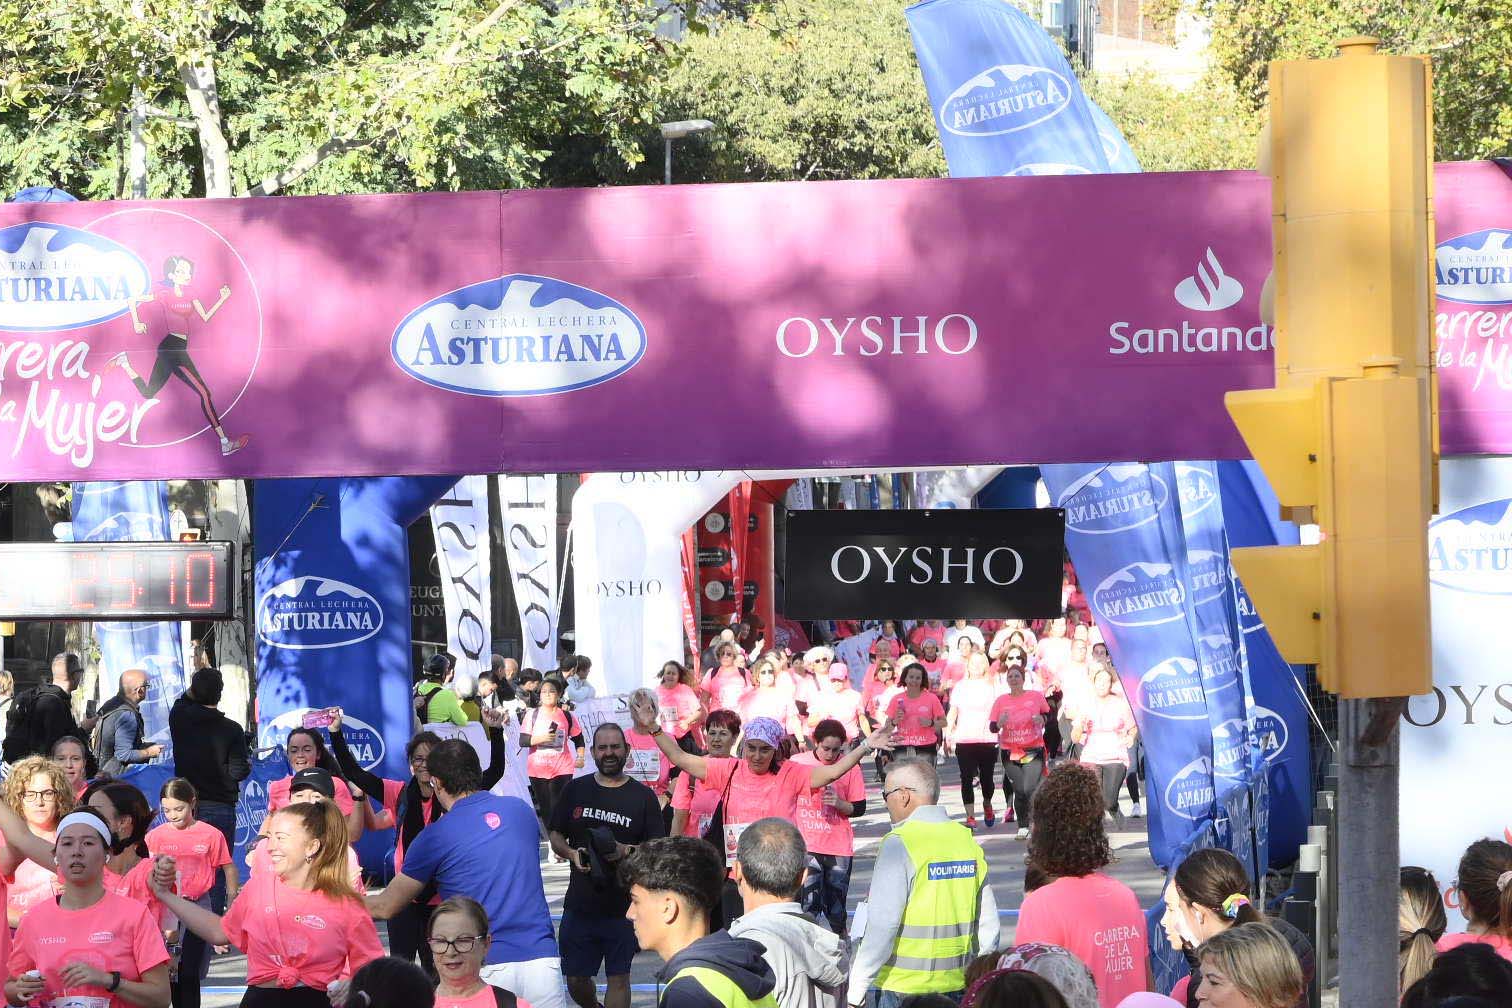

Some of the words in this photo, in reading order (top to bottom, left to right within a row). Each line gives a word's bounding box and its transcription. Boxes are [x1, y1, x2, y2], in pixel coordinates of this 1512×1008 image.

[450, 316, 530, 331] CENTRAL
[537, 314, 619, 329] LECHERA
[775, 313, 978, 358] OYSHO
[411, 322, 626, 367] ASTURIANA
[1109, 320, 1275, 355] Santand
[11, 373, 161, 469] Mujer
[830, 545, 1025, 586] OYSHO
[273, 601, 316, 610] CENTRAL
[320, 600, 370, 609] LECHERA
[262, 606, 375, 634] ASTURIANA
[1402, 685, 1512, 729] OYS
[582, 806, 632, 829] ELEMENT
[928, 864, 976, 878] VOLUNTARIS
[1094, 926, 1140, 949] CARRERA
[1117, 943, 1130, 957] LA
